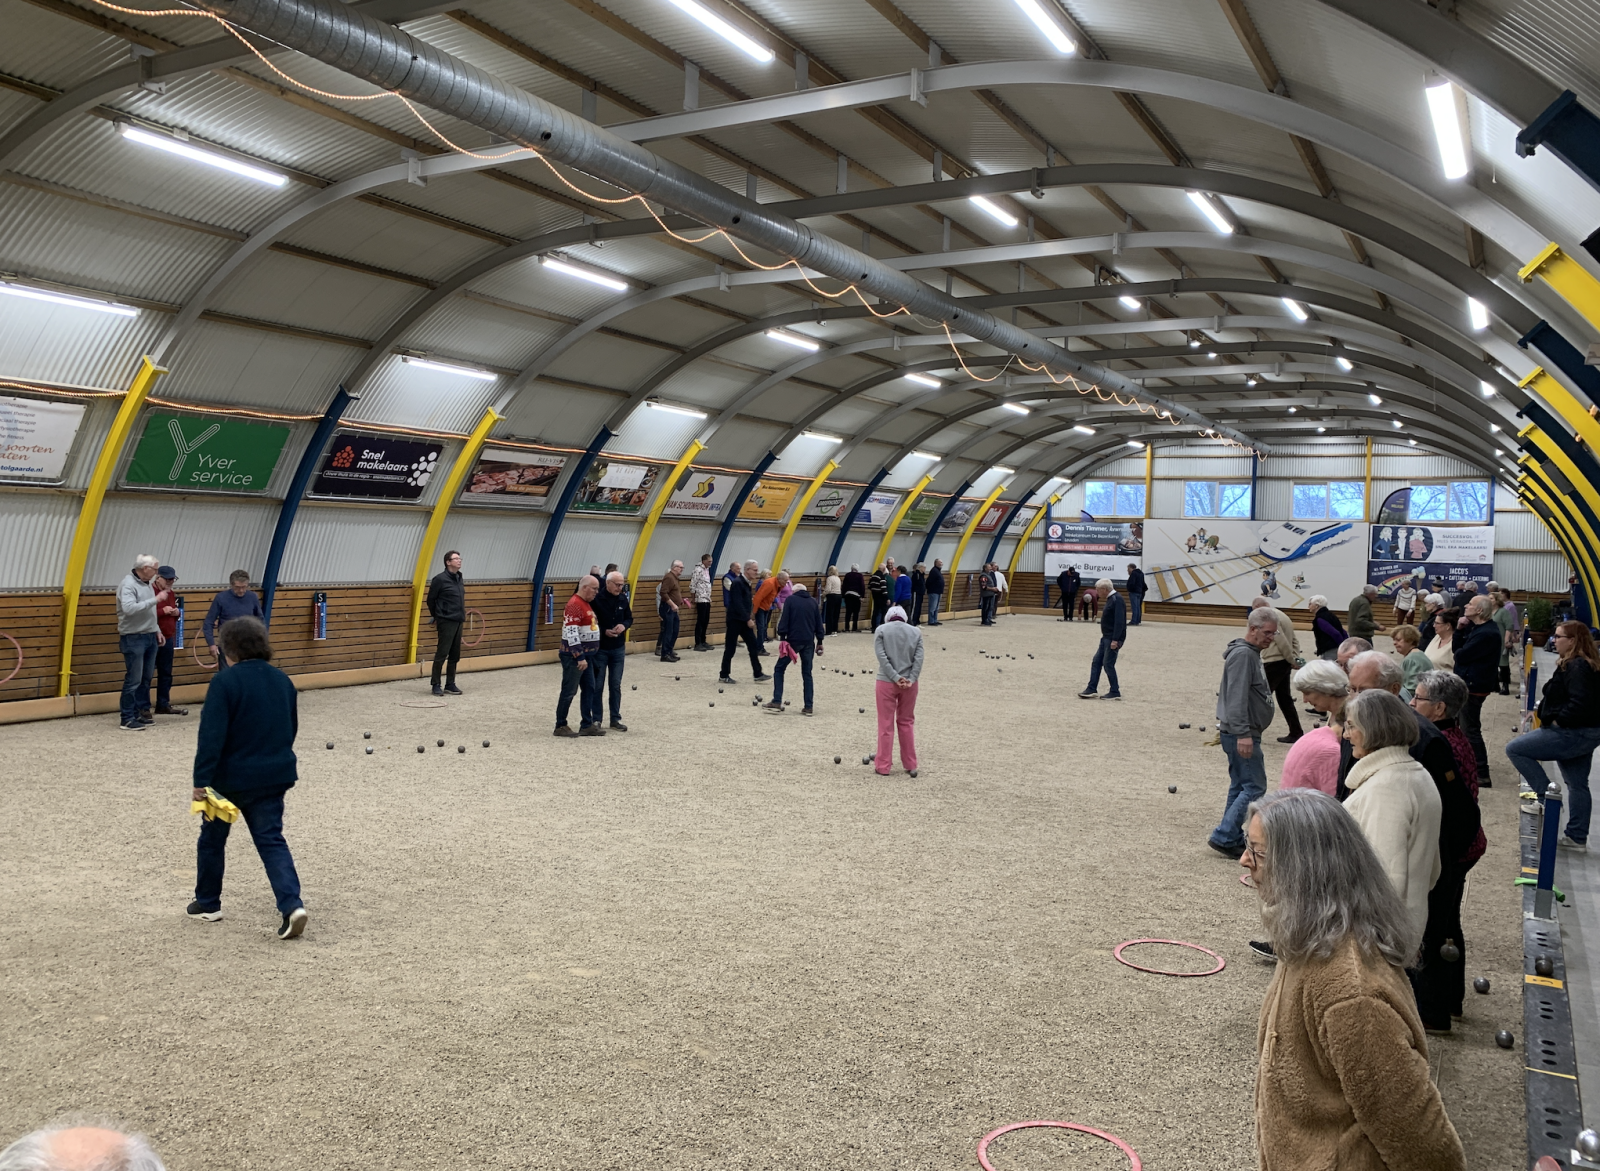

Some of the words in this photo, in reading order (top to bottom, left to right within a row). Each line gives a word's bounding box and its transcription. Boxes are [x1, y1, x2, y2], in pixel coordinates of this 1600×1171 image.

[5, 444, 55, 453] soorten
[361, 449, 385, 460] Snel
[197, 453, 237, 470] Yver
[356, 460, 409, 472] makelaars
[189, 469, 253, 486] service
[667, 500, 678, 508] VAN
[677, 501, 710, 511] SCHOONHOVEN
[1072, 562, 1082, 570] de
[1083, 563, 1115, 572] Burgwal
[1449, 567, 1469, 575] JACCO'S
